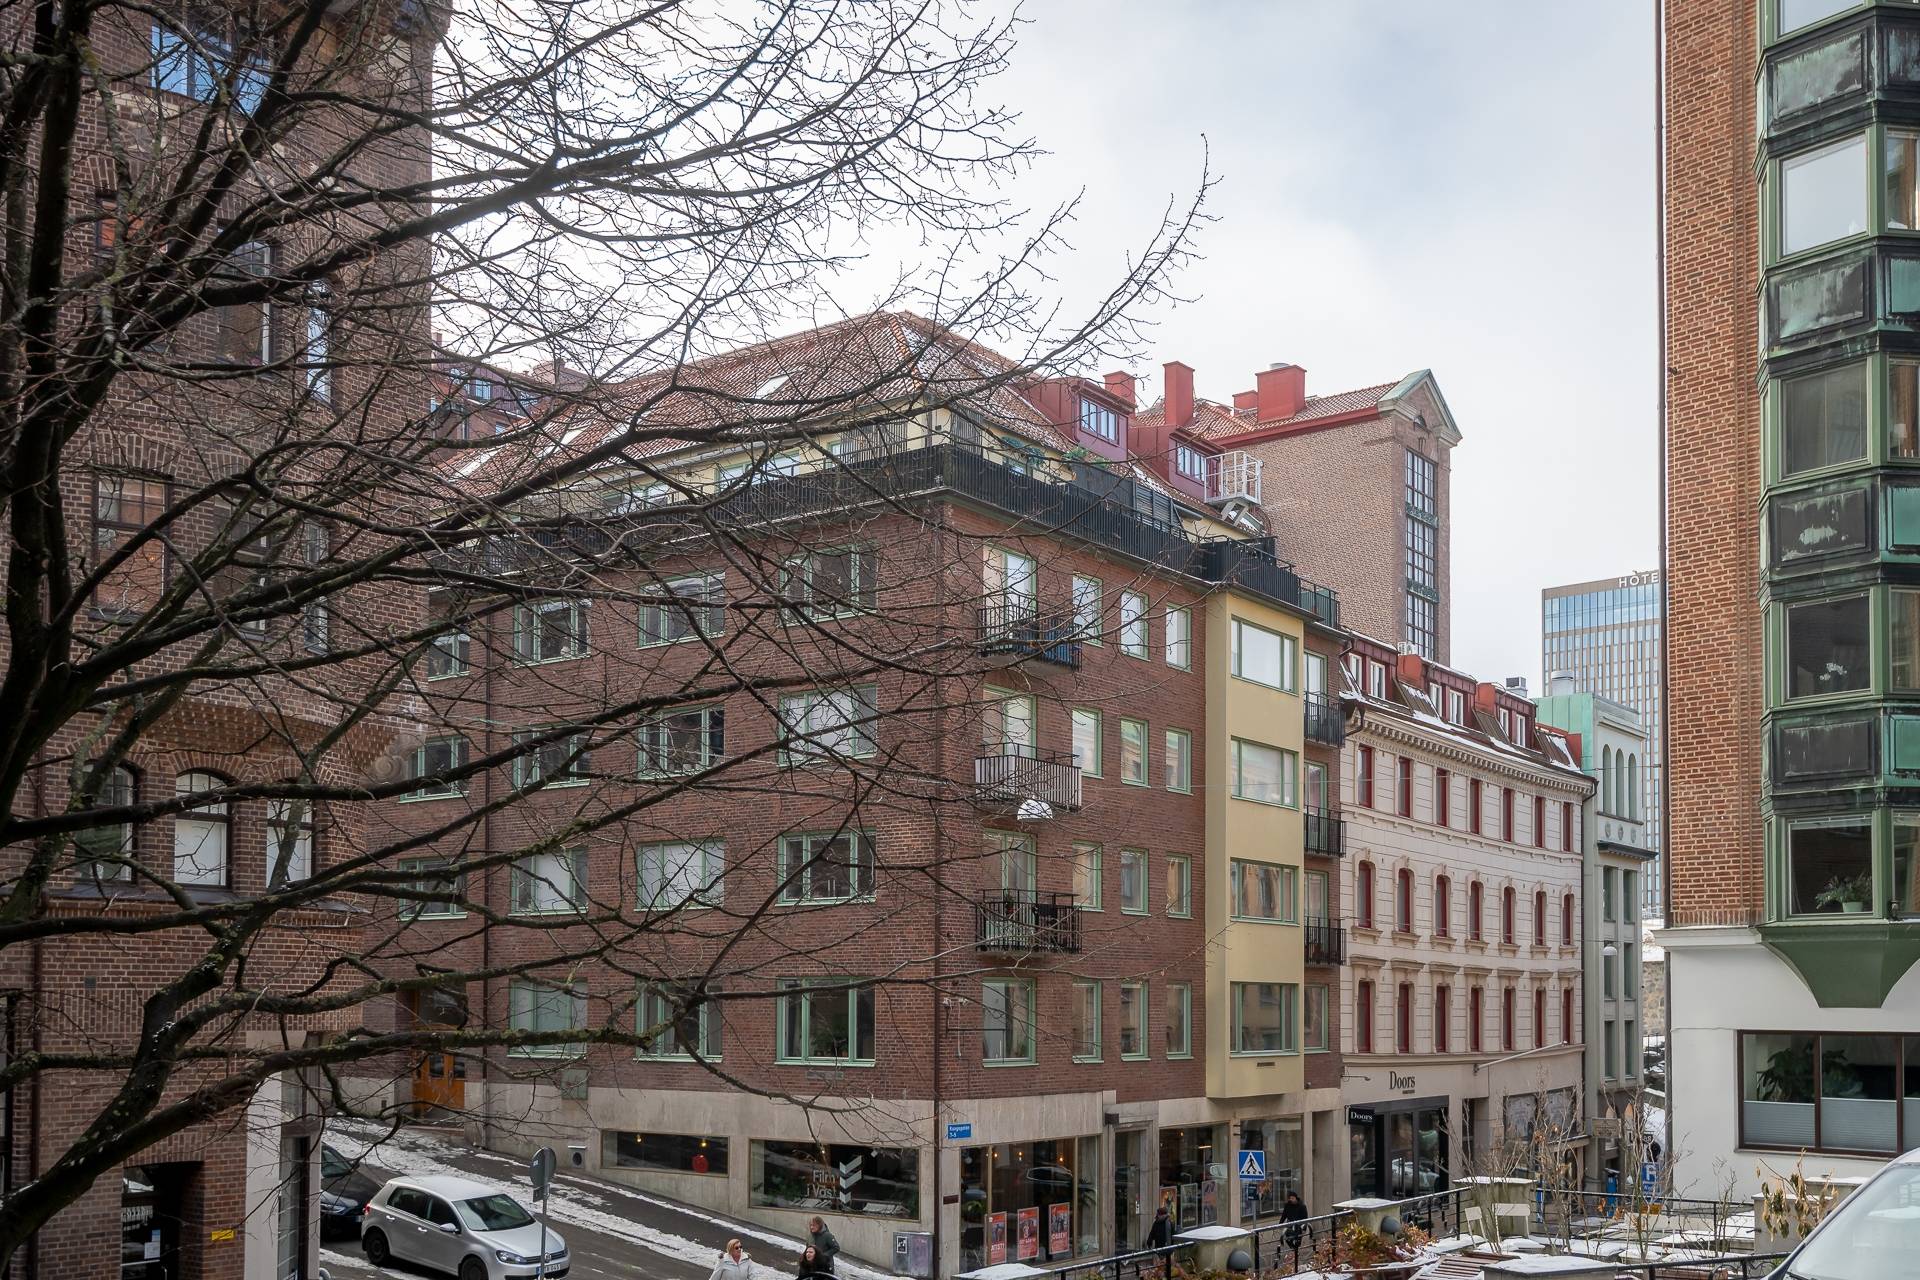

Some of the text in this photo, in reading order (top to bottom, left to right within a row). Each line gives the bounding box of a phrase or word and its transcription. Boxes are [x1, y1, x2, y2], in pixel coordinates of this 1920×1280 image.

[1619, 572, 1660, 588] HOTE
[1389, 1070, 1416, 1090] Doors
[1350, 1111, 1373, 1121] Doors
